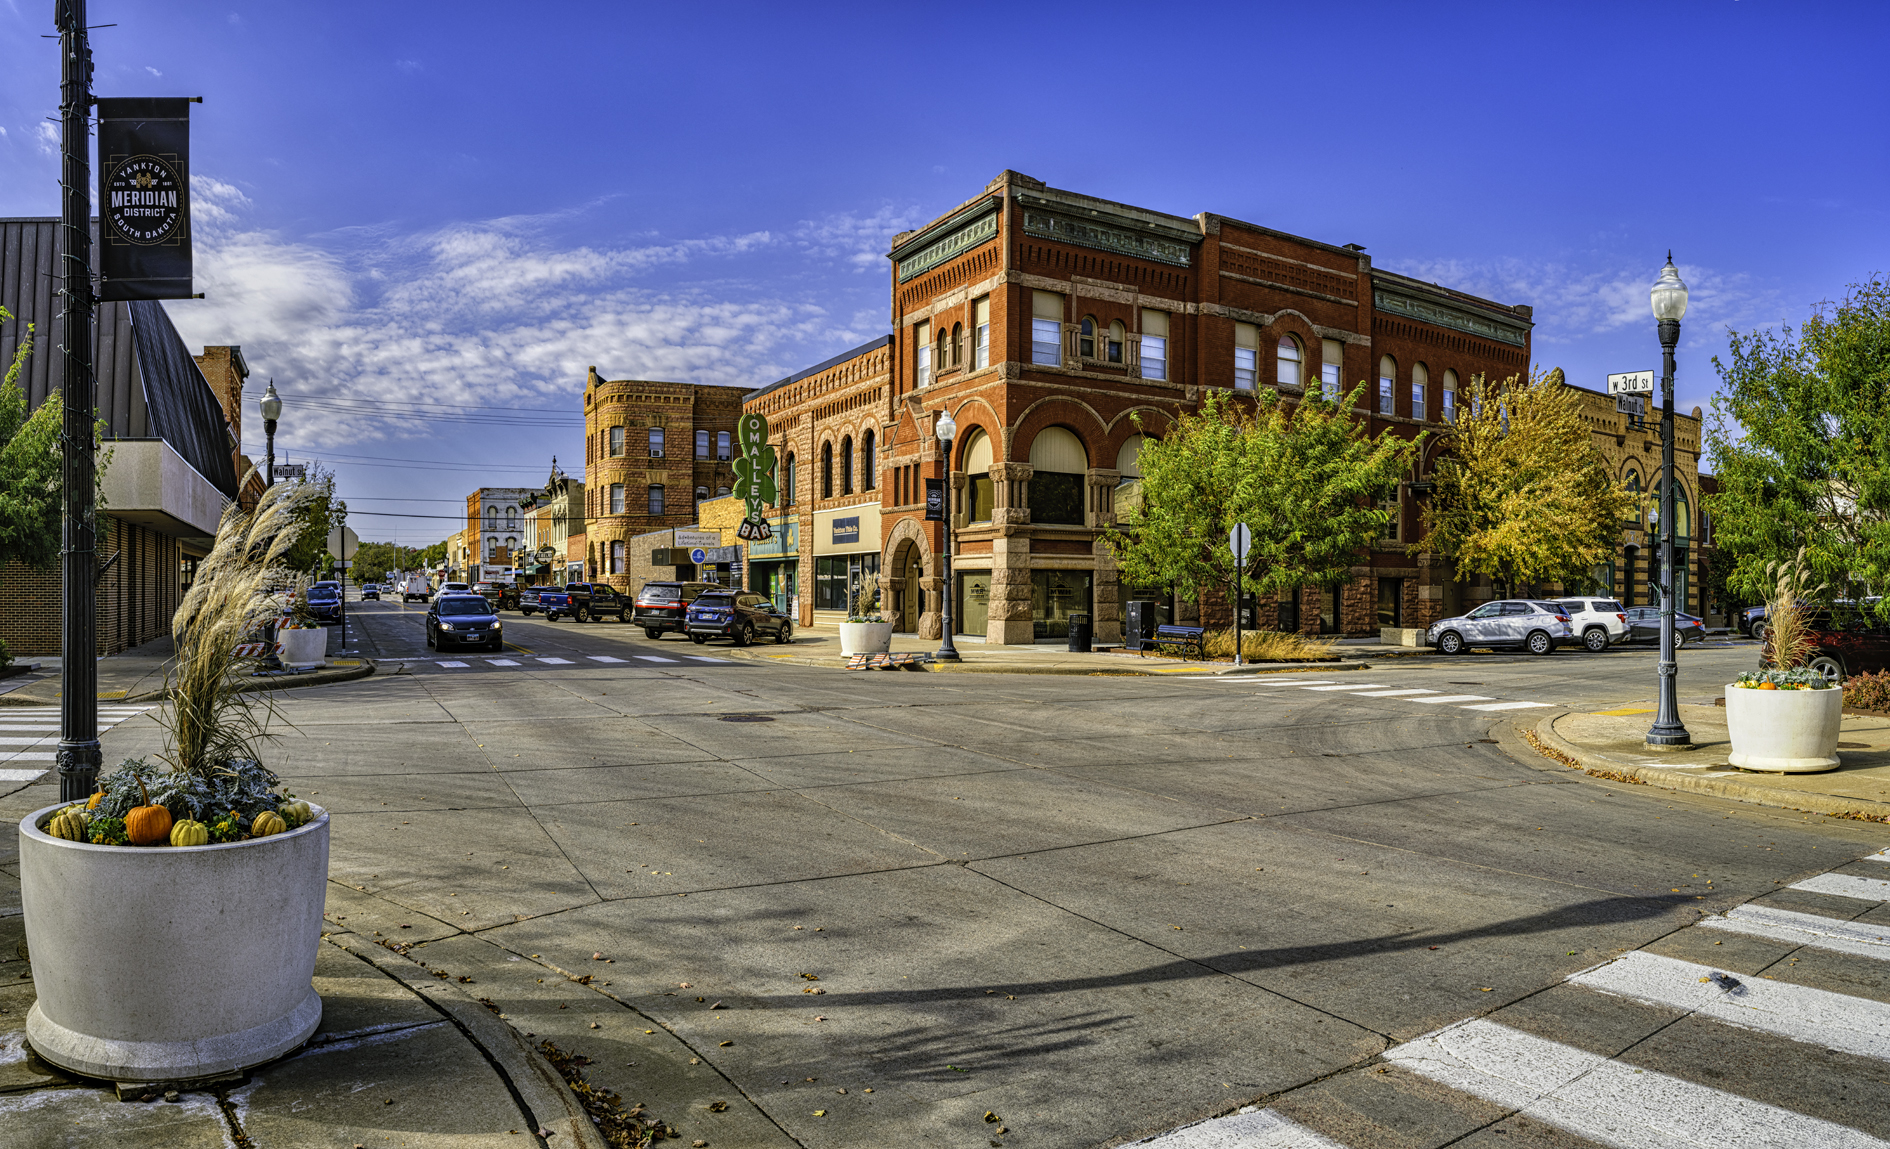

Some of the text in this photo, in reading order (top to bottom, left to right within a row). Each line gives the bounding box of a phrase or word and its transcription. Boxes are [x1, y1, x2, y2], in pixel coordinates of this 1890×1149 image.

[120, 162, 167, 178] YANKTON
[111, 190, 177, 208] MERIDIAN
[123, 207, 165, 217] DISTRICT
[114, 212, 177, 239] SOUTH DAKOTA
[1622, 375, 1637, 390] 3rd
[1642, 378, 1648, 389] St
[1617, 394, 1638, 413] Walnut
[274, 467, 295, 476] Walnut
[740, 523, 771, 540] BAR
